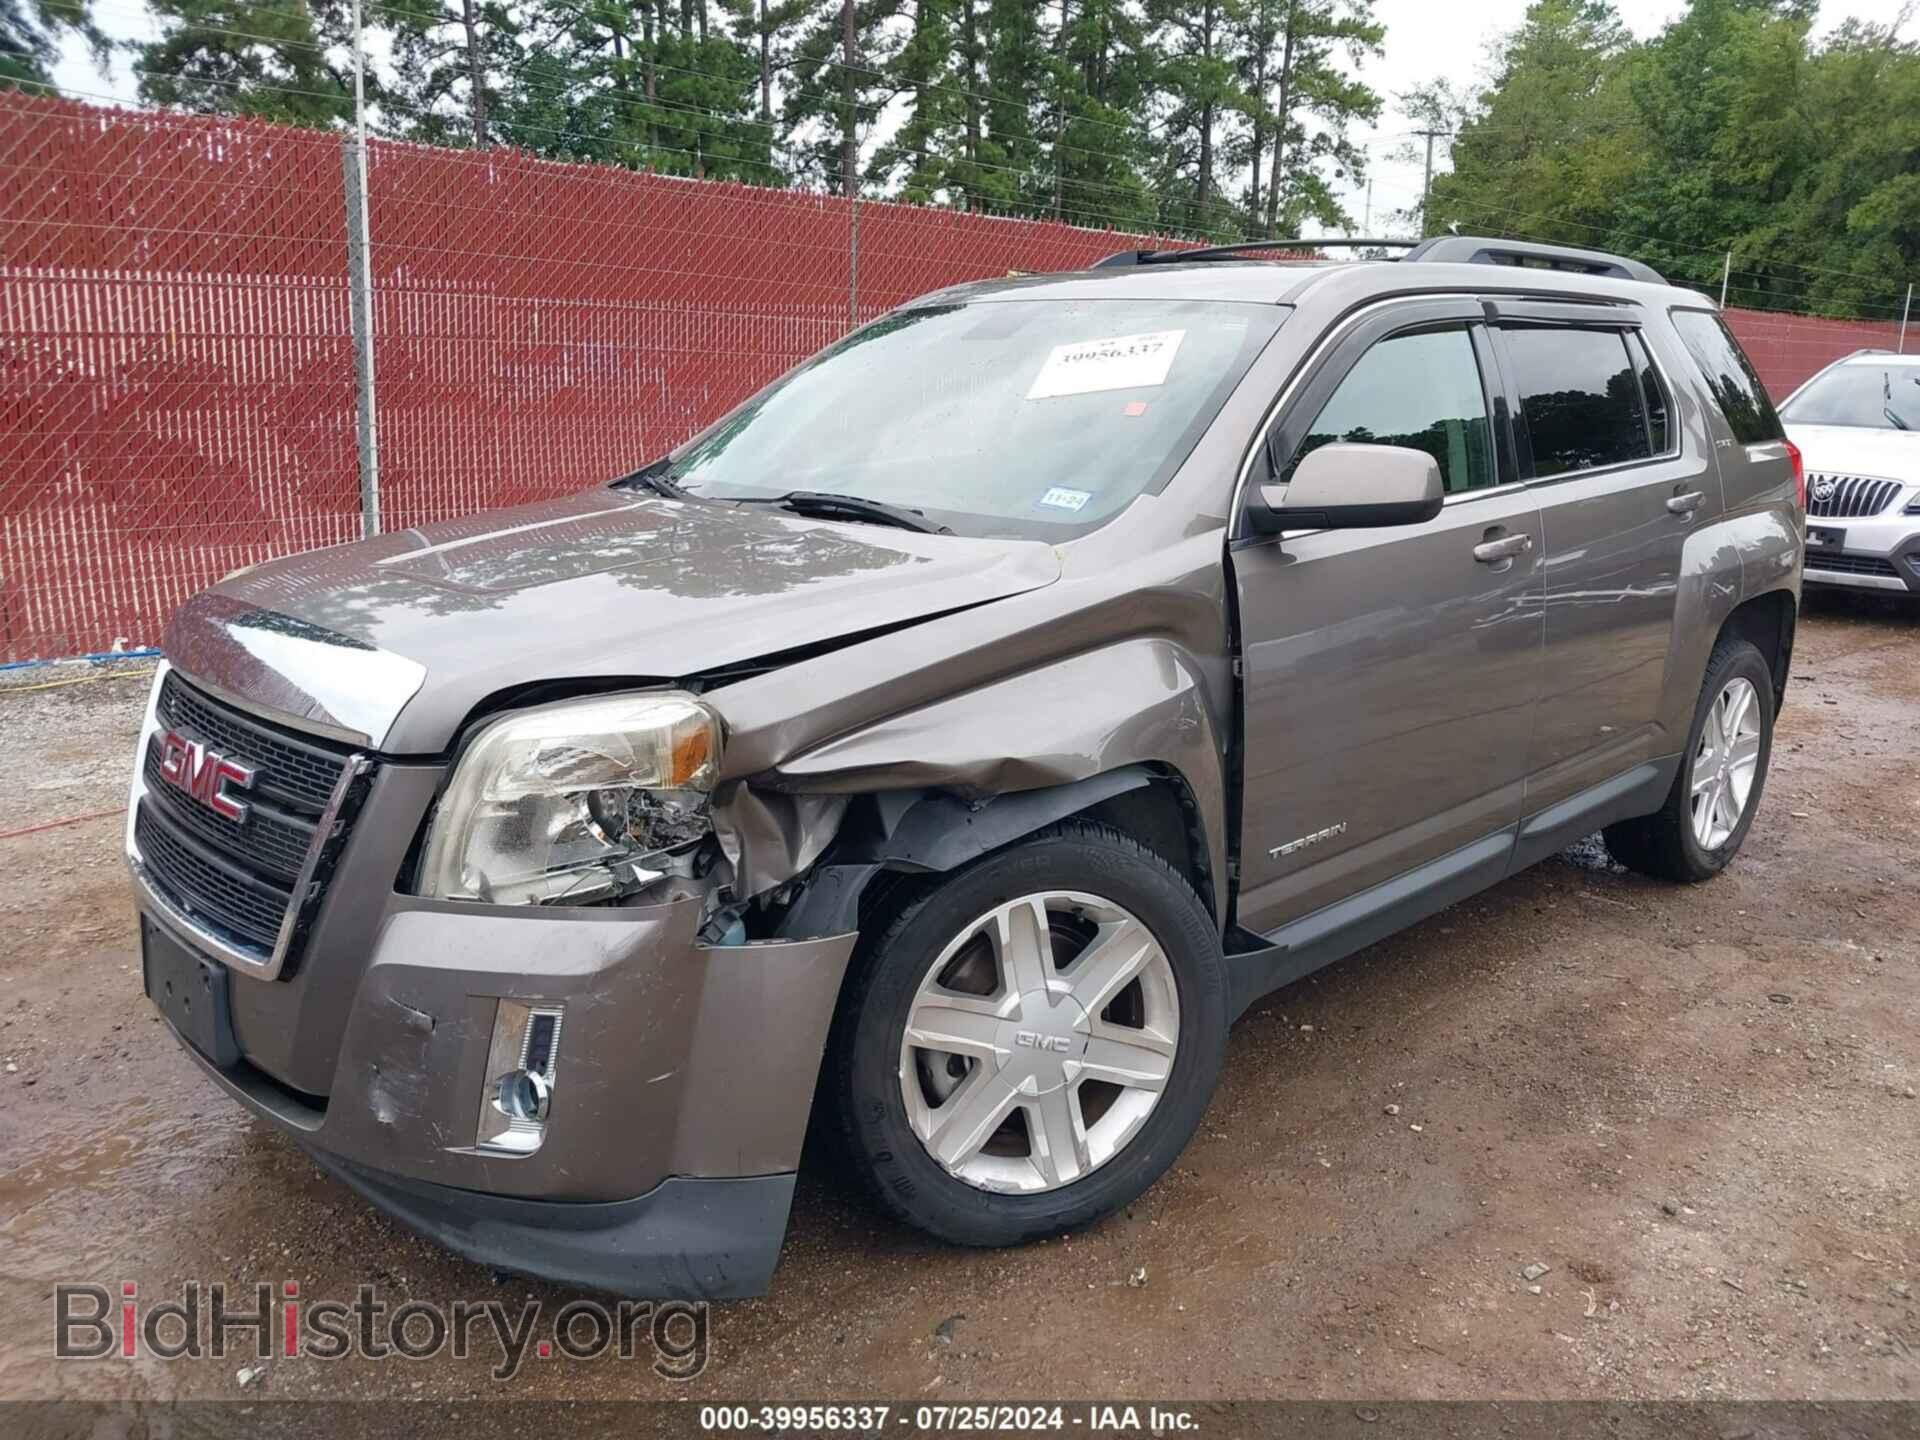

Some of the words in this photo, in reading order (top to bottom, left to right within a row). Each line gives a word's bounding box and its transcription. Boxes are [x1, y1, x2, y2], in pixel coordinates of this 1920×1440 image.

[159, 732, 254, 823] GMC
[1268, 821, 1348, 859] TERRAIN
[1015, 1030, 1071, 1053] GMC
